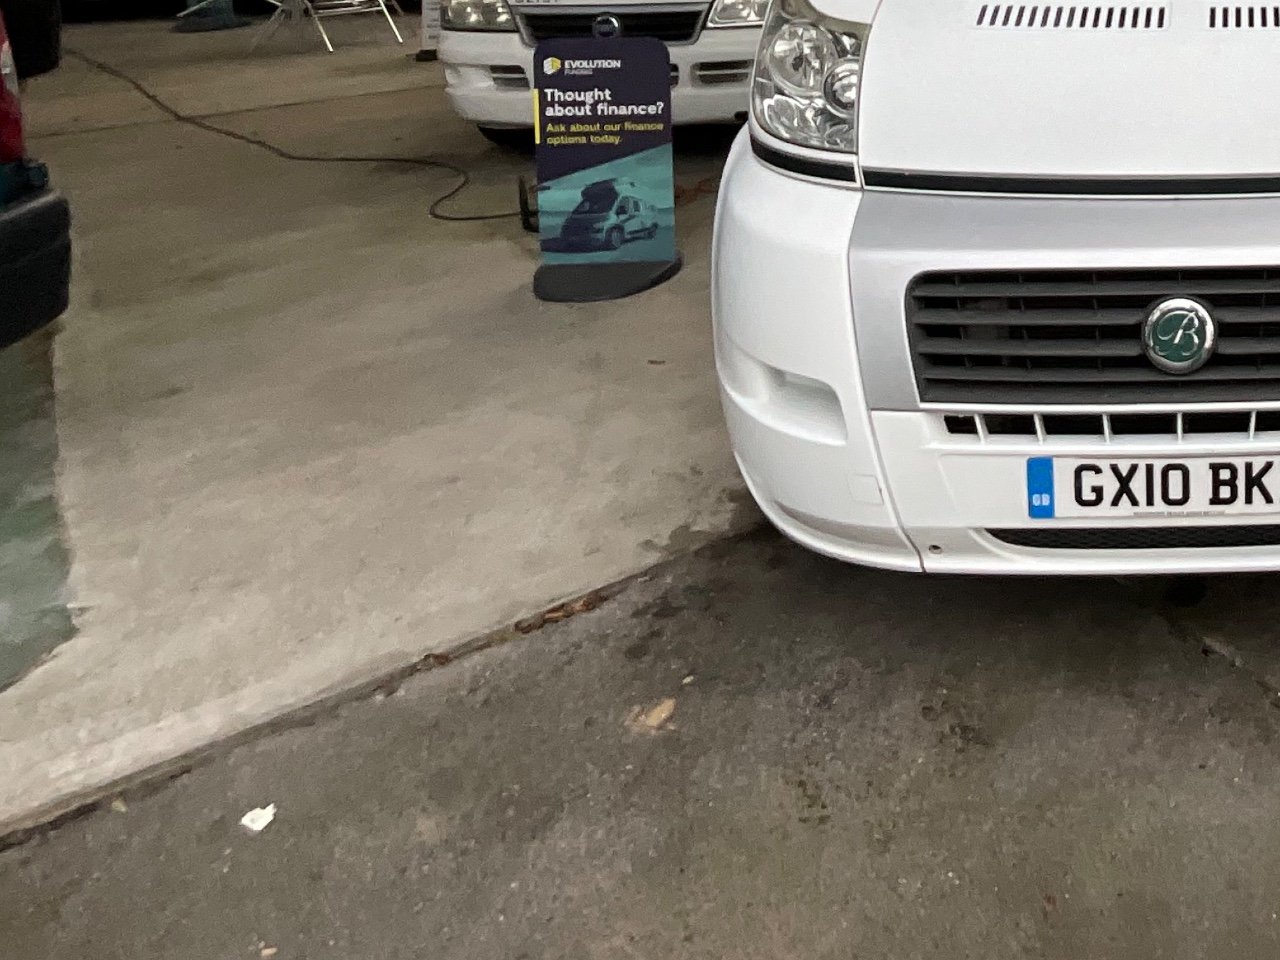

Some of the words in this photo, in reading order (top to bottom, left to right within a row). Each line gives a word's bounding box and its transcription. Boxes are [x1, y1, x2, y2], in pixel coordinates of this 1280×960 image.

[564, 59, 621, 69] EVOLUTION
[544, 87, 611, 104] Thought
[545, 103, 592, 117] about
[597, 101, 664, 116] finance?
[546, 123, 566, 132] Ask
[569, 122, 600, 132] about
[624, 121, 664, 131] finance
[546, 135, 587, 146] options
[1073, 463, 1191, 507] GX10
